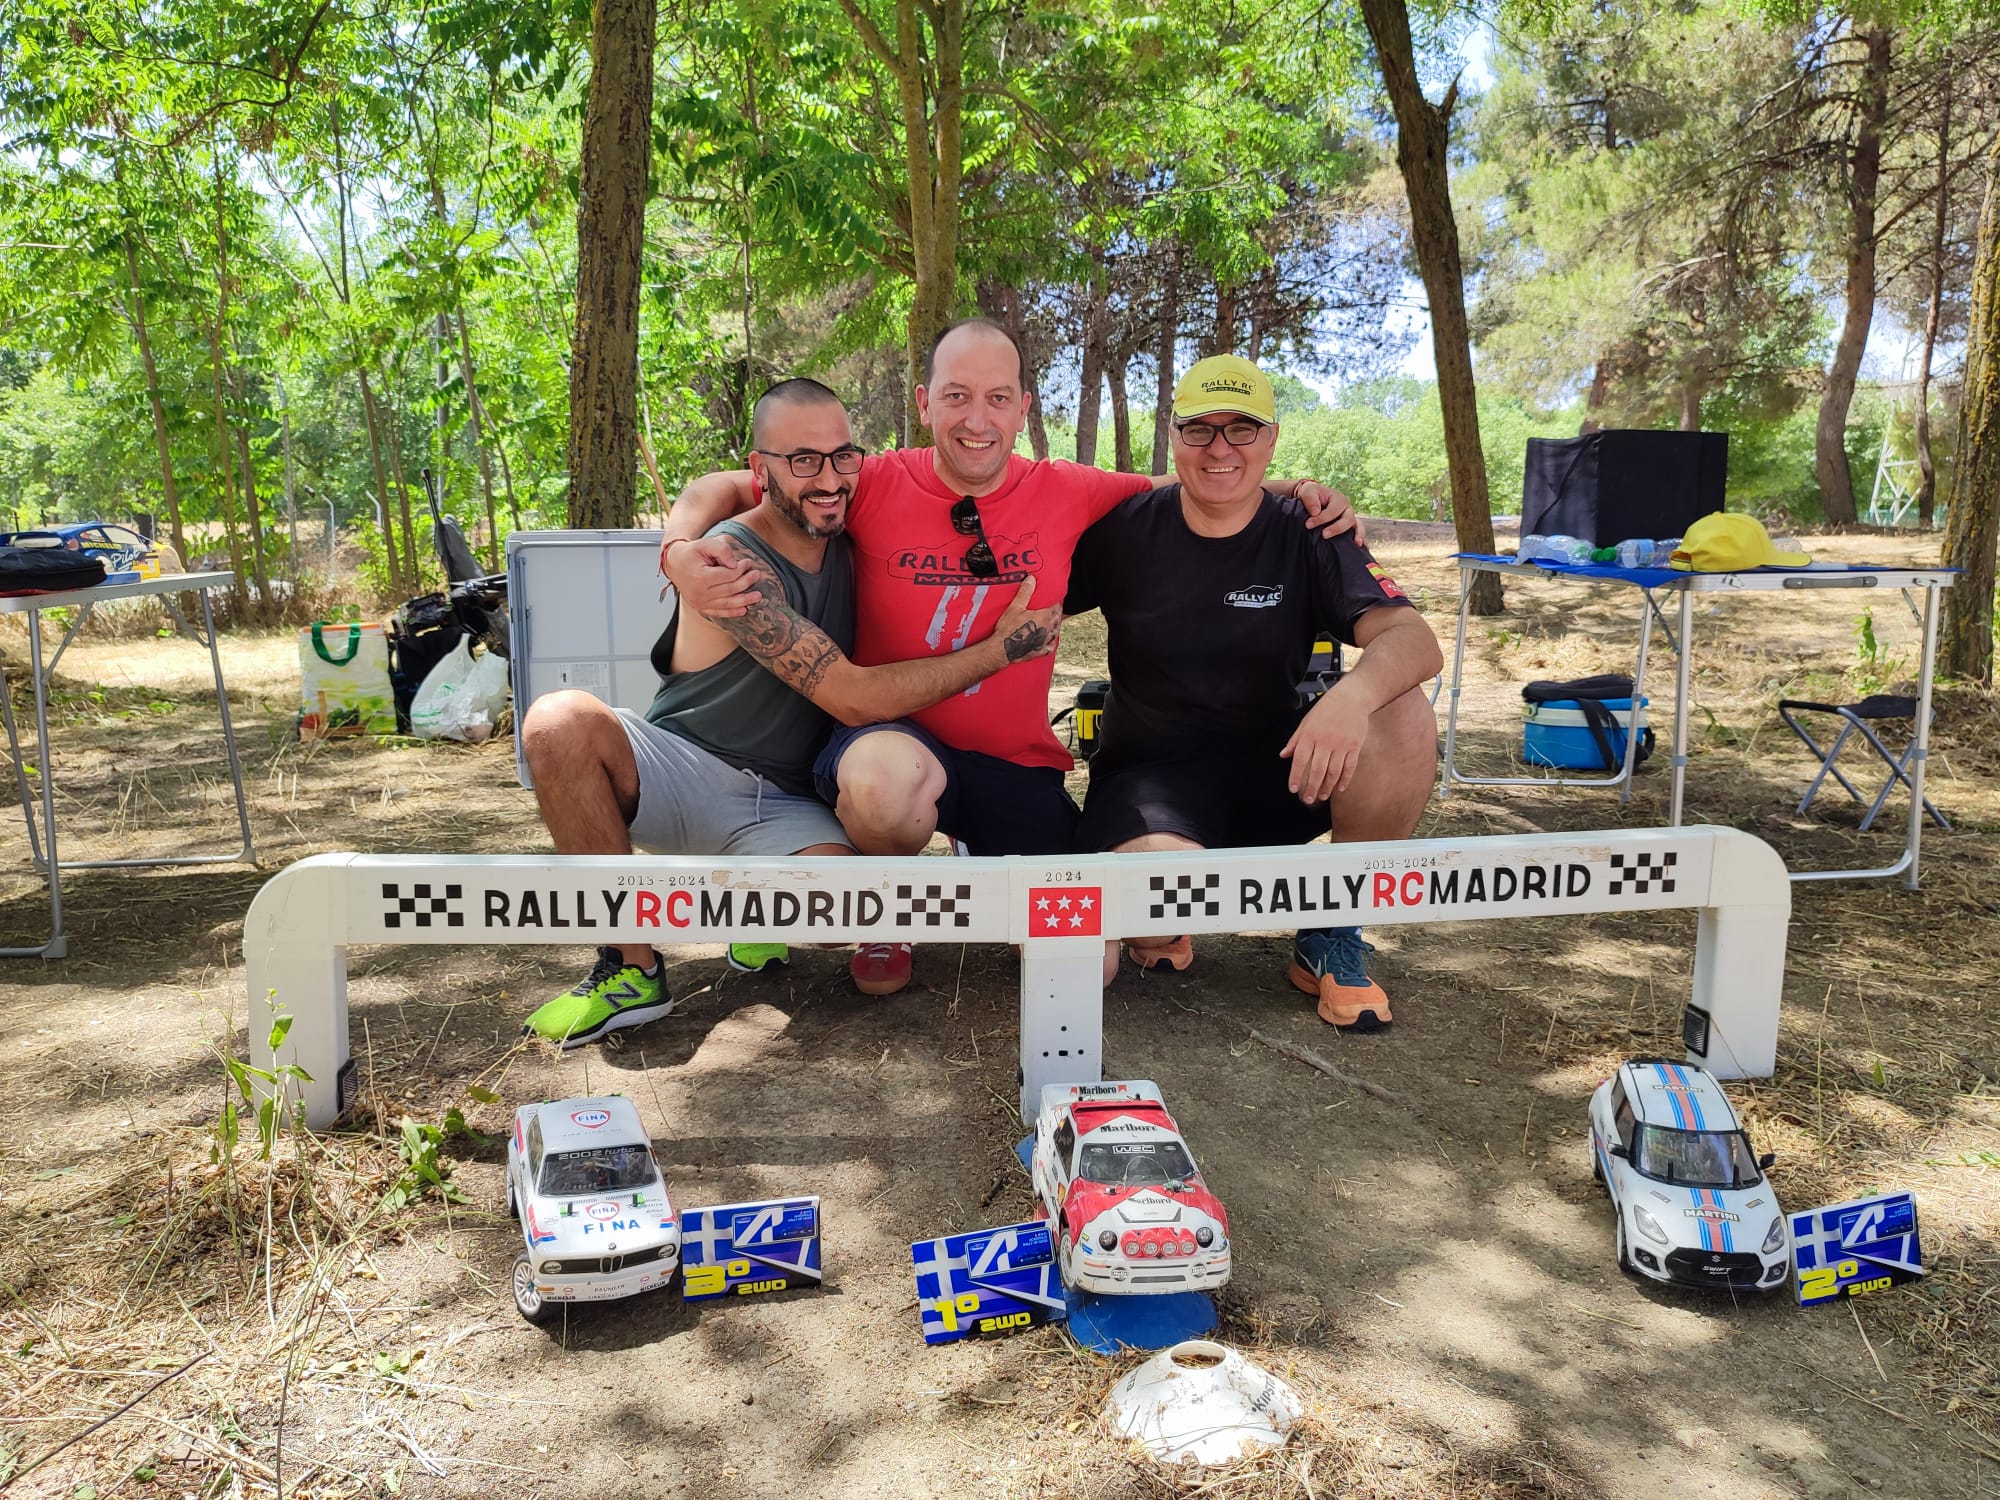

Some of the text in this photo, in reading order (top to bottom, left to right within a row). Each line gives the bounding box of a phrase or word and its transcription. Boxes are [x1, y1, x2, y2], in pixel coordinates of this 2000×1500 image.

[1201, 379, 1238, 388] RALLY
[1242, 382, 1254, 391] RC
[111, 545, 140, 569] Pilot
[899, 550, 1037, 571] RALL RC
[917, 573, 1025, 584] MADRID
[1228, 592, 1281, 602] RALLY RC
[1364, 857, 1437, 870] 2013-2024
[1045, 870, 1082, 883] 2024
[1079, 1085, 1117, 1095] Marlboro
[576, 1113, 607, 1122] FINA
[558, 1150, 603, 1160] 2002
[1128, 1196, 1172, 1205] rlboro
[591, 1205, 618, 1216] FINA
[1683, 1208, 1740, 1222] MARTINI
[583, 1218, 641, 1234] FINA
[640, 1280, 666, 1291] MICHELIN
